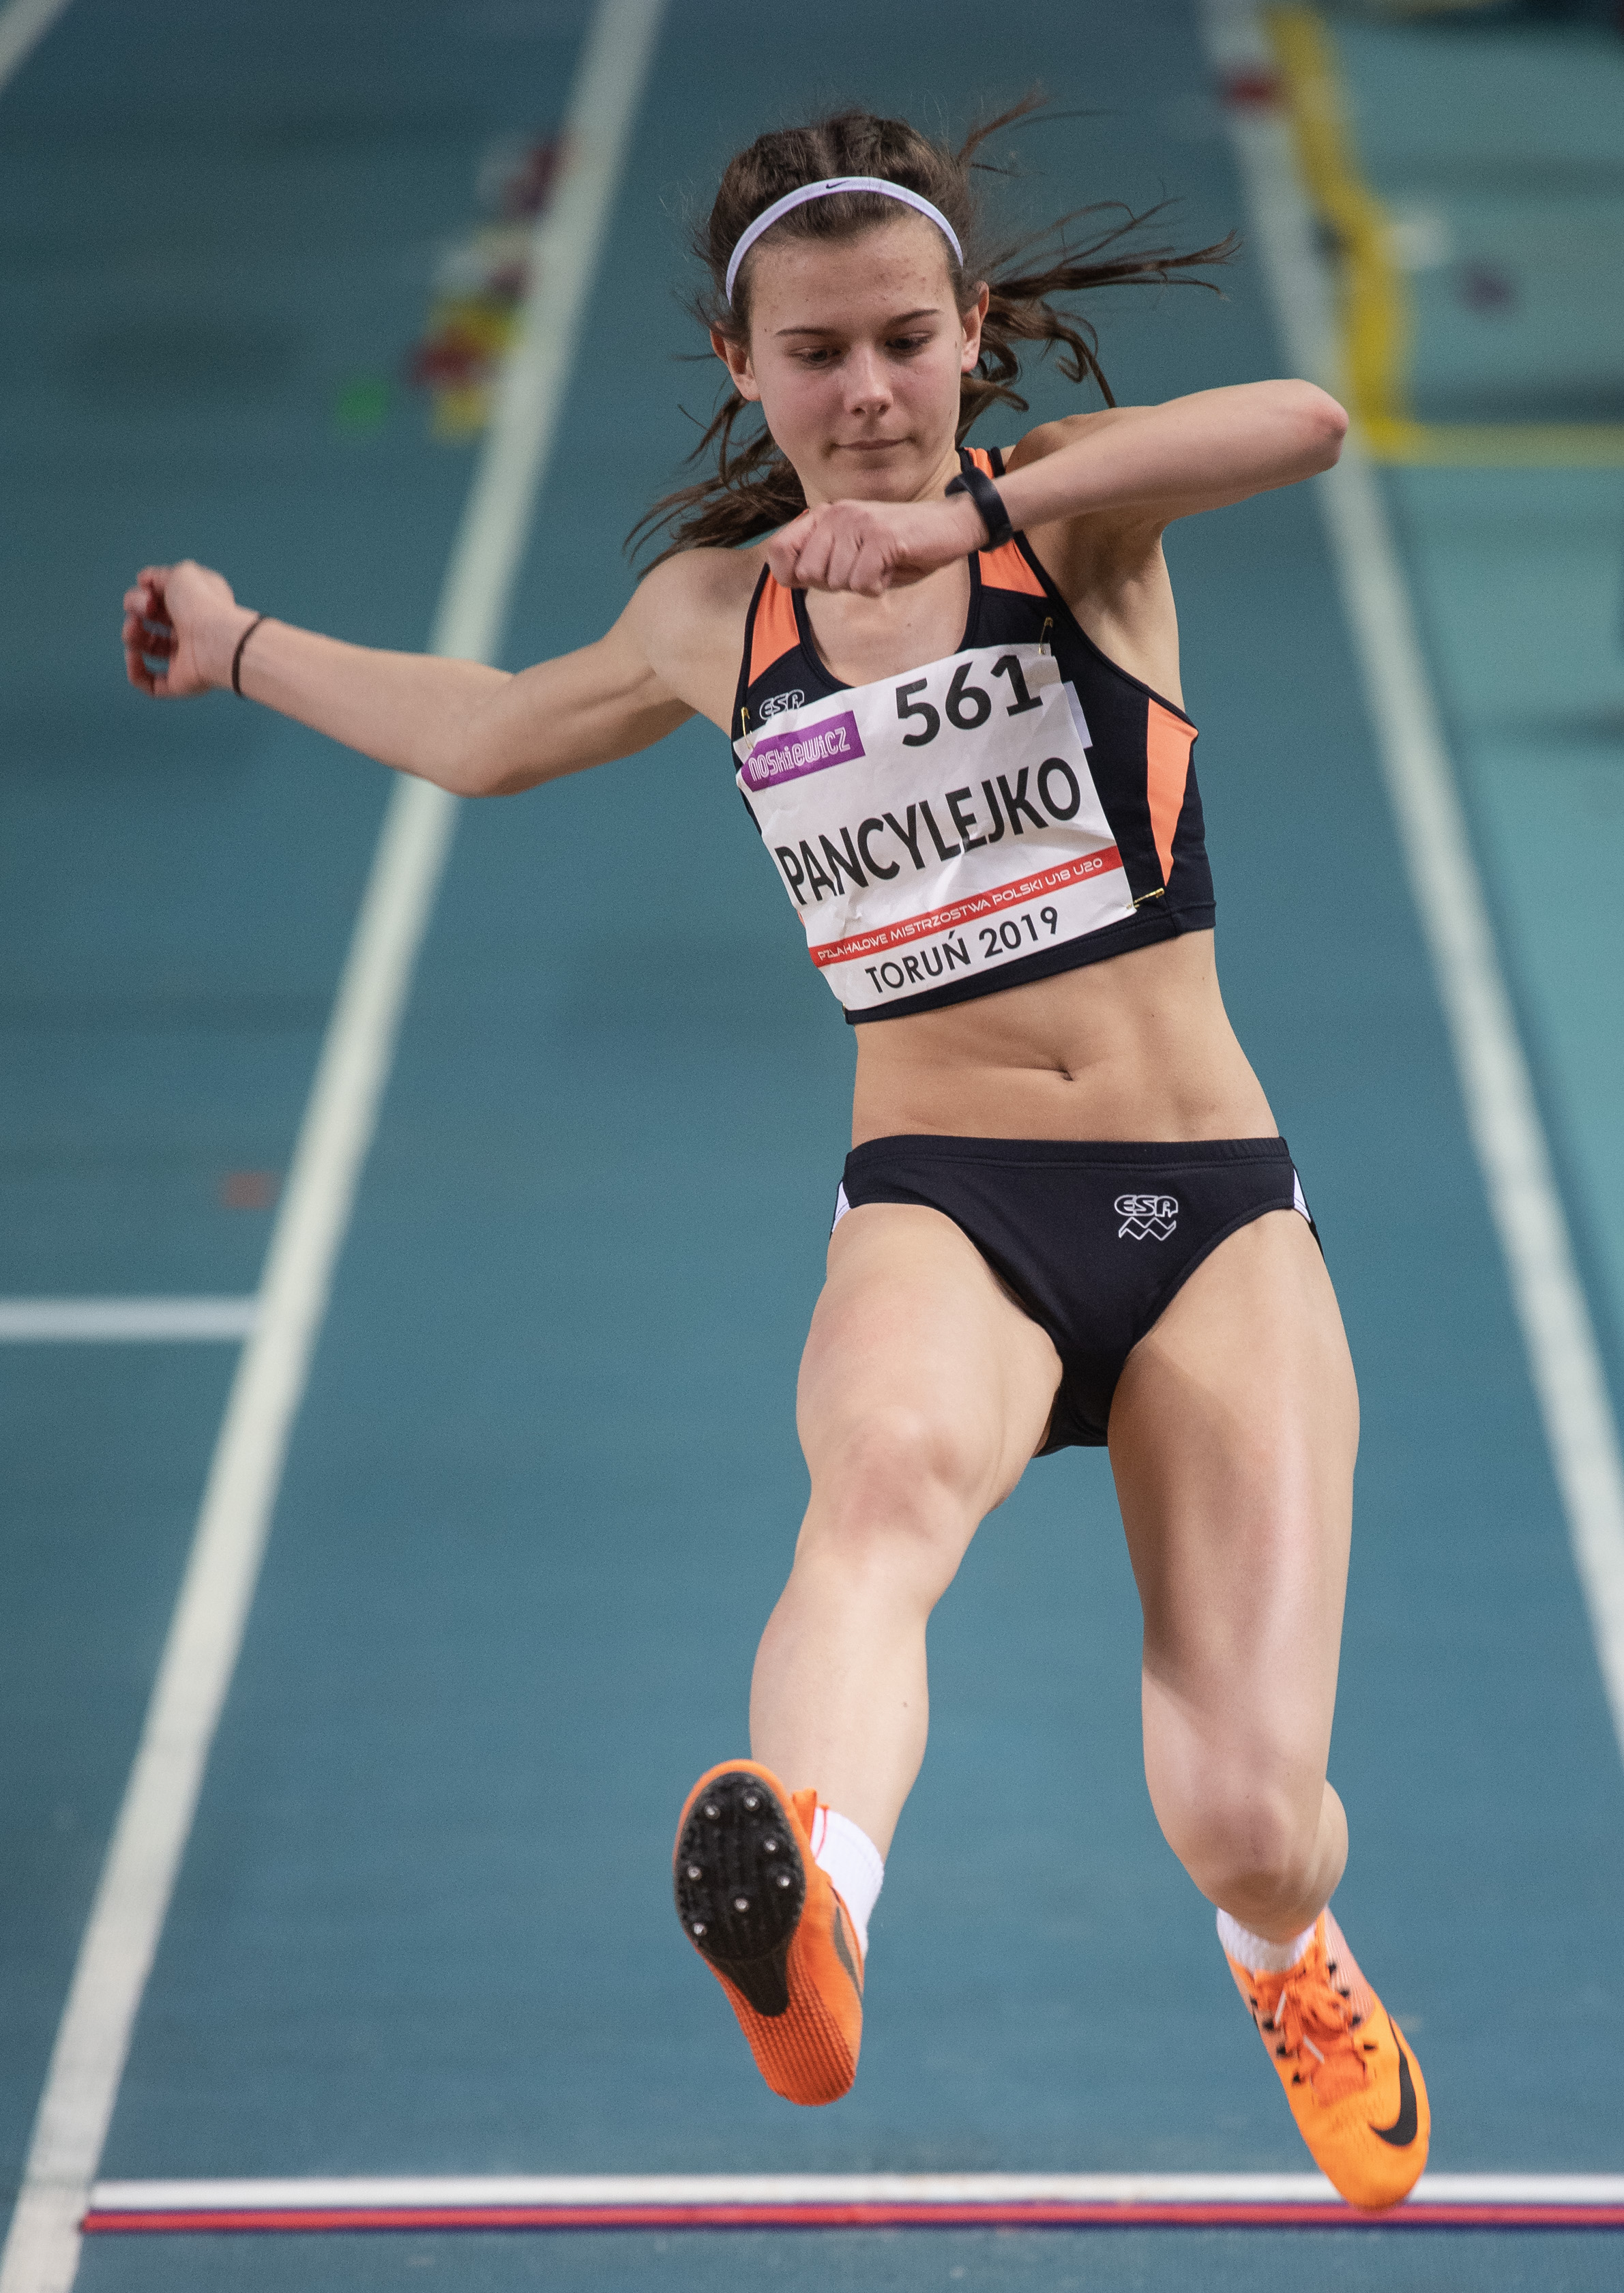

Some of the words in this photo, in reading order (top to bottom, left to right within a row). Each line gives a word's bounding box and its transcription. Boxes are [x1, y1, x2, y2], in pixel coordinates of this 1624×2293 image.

[896, 655, 1044, 747] 561
[774, 757, 1080, 905] PANCYLEJKO
[890, 899, 991, 941] MISTRZOSTWA
[992, 879, 1044, 905] POLSKI
[1045, 869, 1072, 886] U18
[1073, 858, 1104, 876] U20
[865, 930, 971, 993] TORUŃ
[979, 906, 1059, 959] 2019
